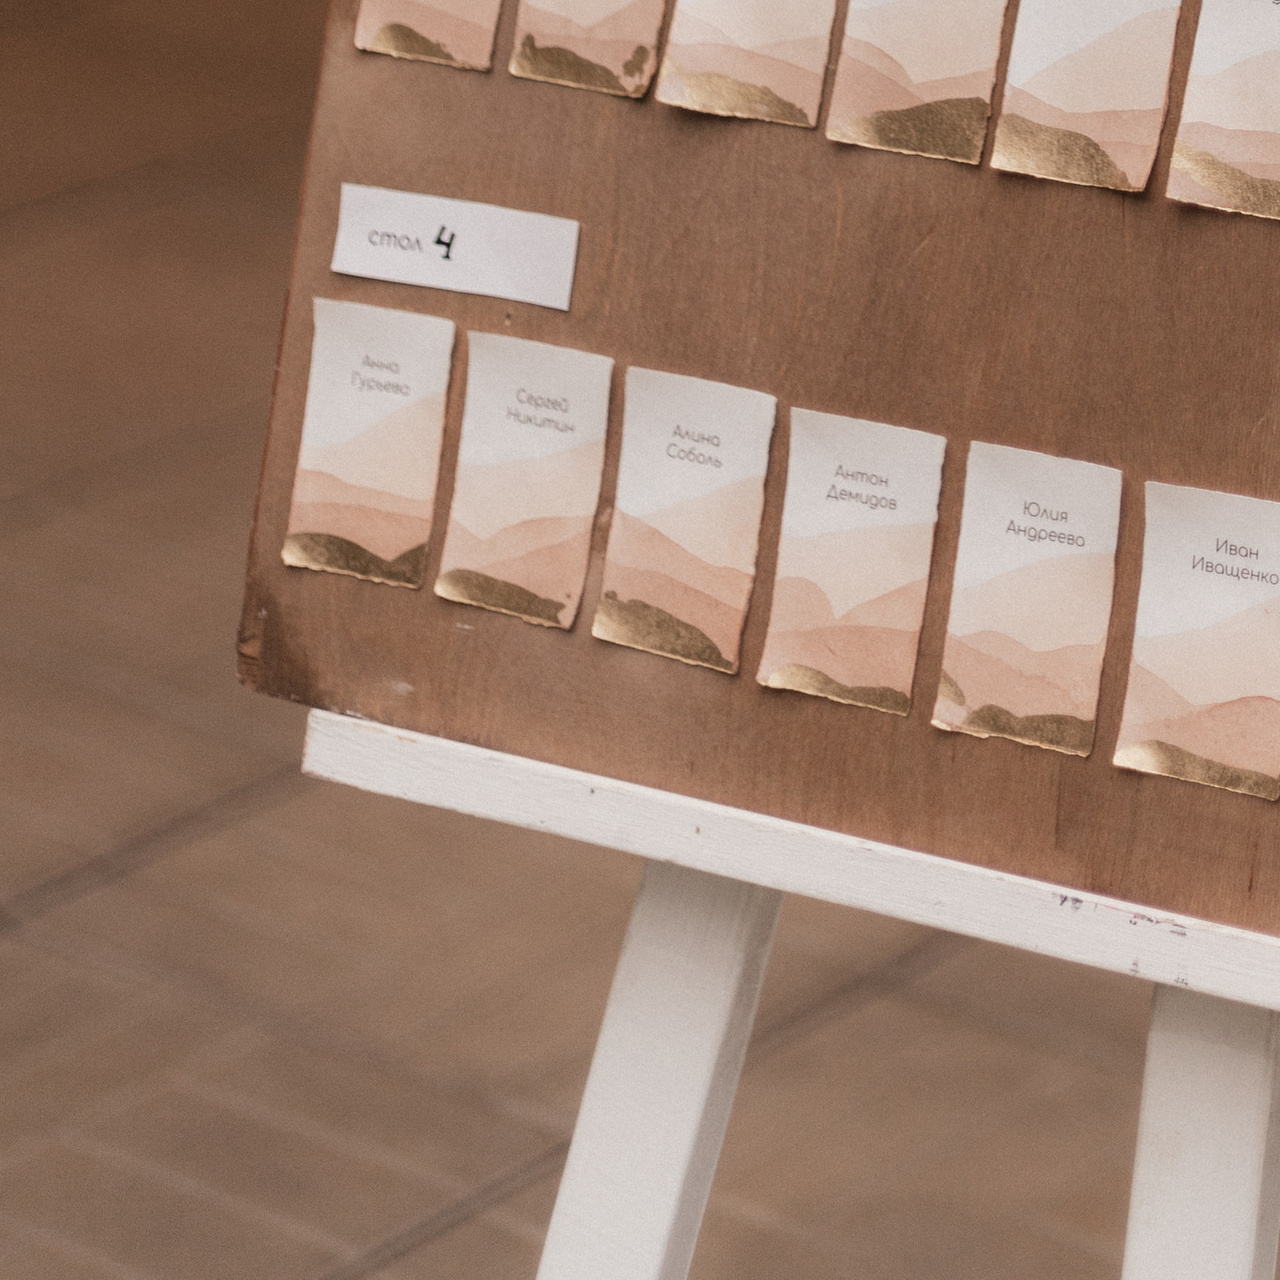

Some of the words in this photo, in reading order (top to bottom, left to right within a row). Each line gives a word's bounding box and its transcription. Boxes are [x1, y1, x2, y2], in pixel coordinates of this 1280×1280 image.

[368, 227, 424, 254] стол
[433, 224, 457, 261] 4
[515, 387, 569, 414] Сергей
[506, 407, 576, 433] Никитин
[672, 424, 722, 449] Алина
[665, 442, 723, 469] Соболь
[834, 464, 890, 487] Антон
[825, 483, 898, 511] Демидов
[1022, 500, 1069, 523] Юлия
[1005, 519, 1086, 548] Андреева
[1214, 538, 1260, 560] Иван
[1191, 555, 1280, 586] Иващенко
